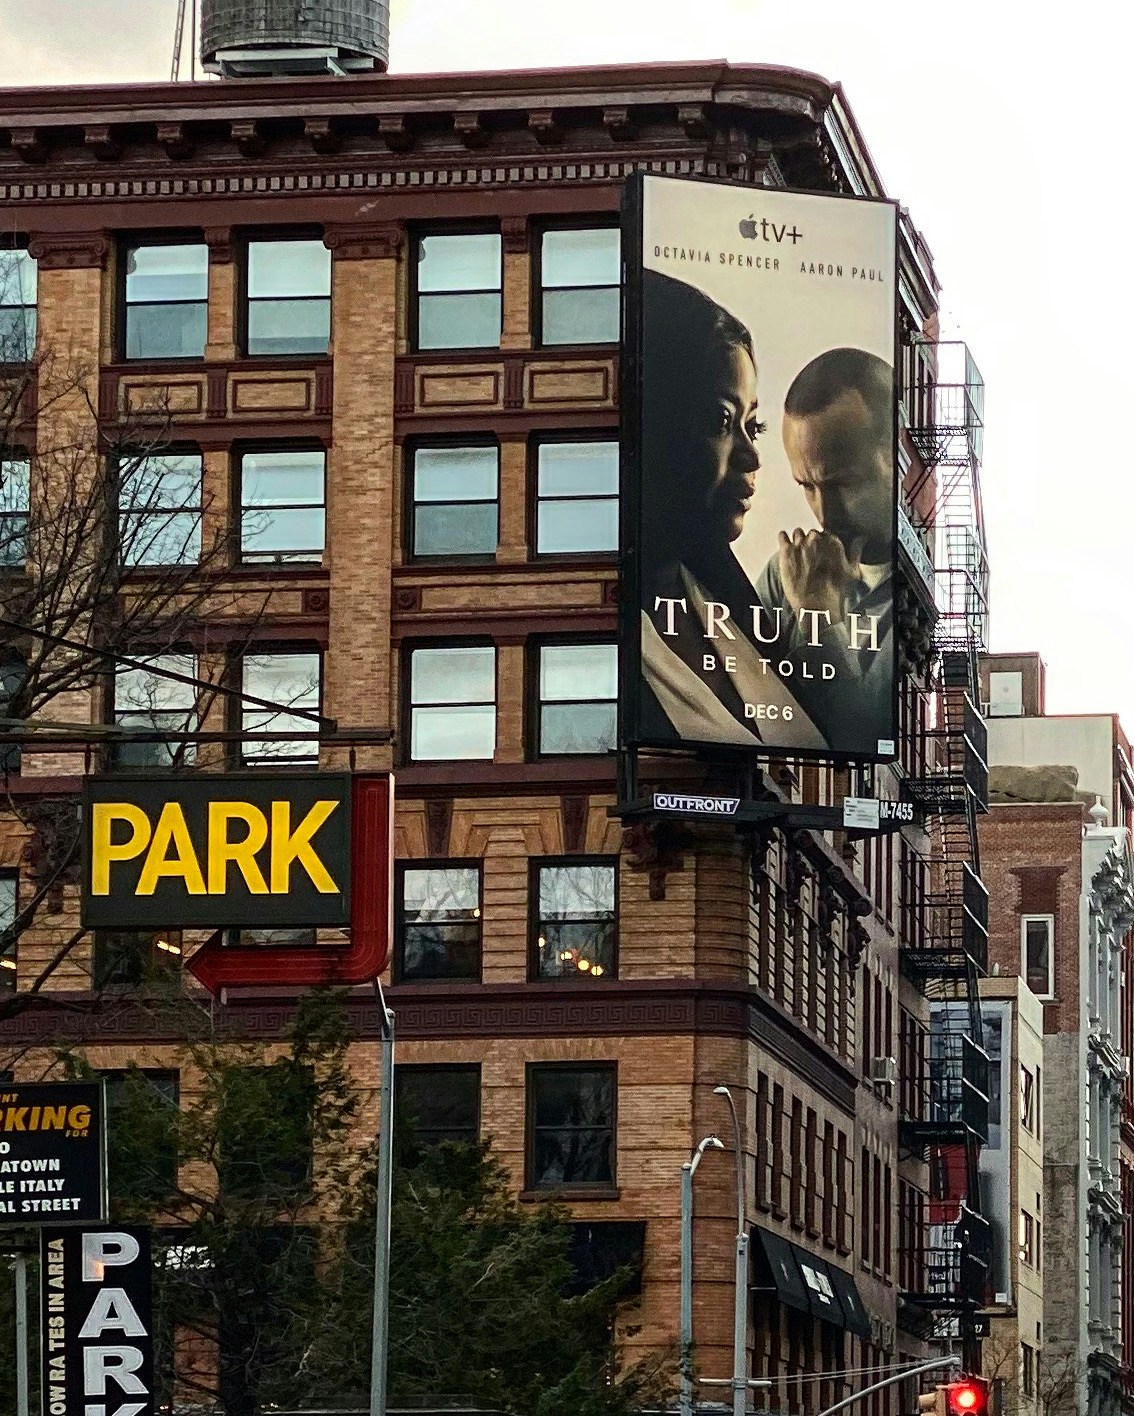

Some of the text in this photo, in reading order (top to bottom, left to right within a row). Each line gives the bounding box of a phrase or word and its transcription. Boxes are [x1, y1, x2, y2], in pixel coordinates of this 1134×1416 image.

[653, 245, 780, 271] OCTAVIA SPENCER
[799, 261, 885, 283] AARON PAUL
[654, 595, 882, 652] TRUTH
[702, 654, 836, 680] BE TOLD
[744, 703, 793, 721] DEC 6
[656, 795, 735, 813] OUTFRONT
[879, 801, 914, 821] M-7455
[91, 800, 341, 896] PARK
[0, 1105, 92, 1132] KING
[19, 1178, 66, 1193] ITALY
[21, 1197, 81, 1213] STREET
[47, 1238, 65, 1289] AREA
[48, 1293, 65, 1312] IN
